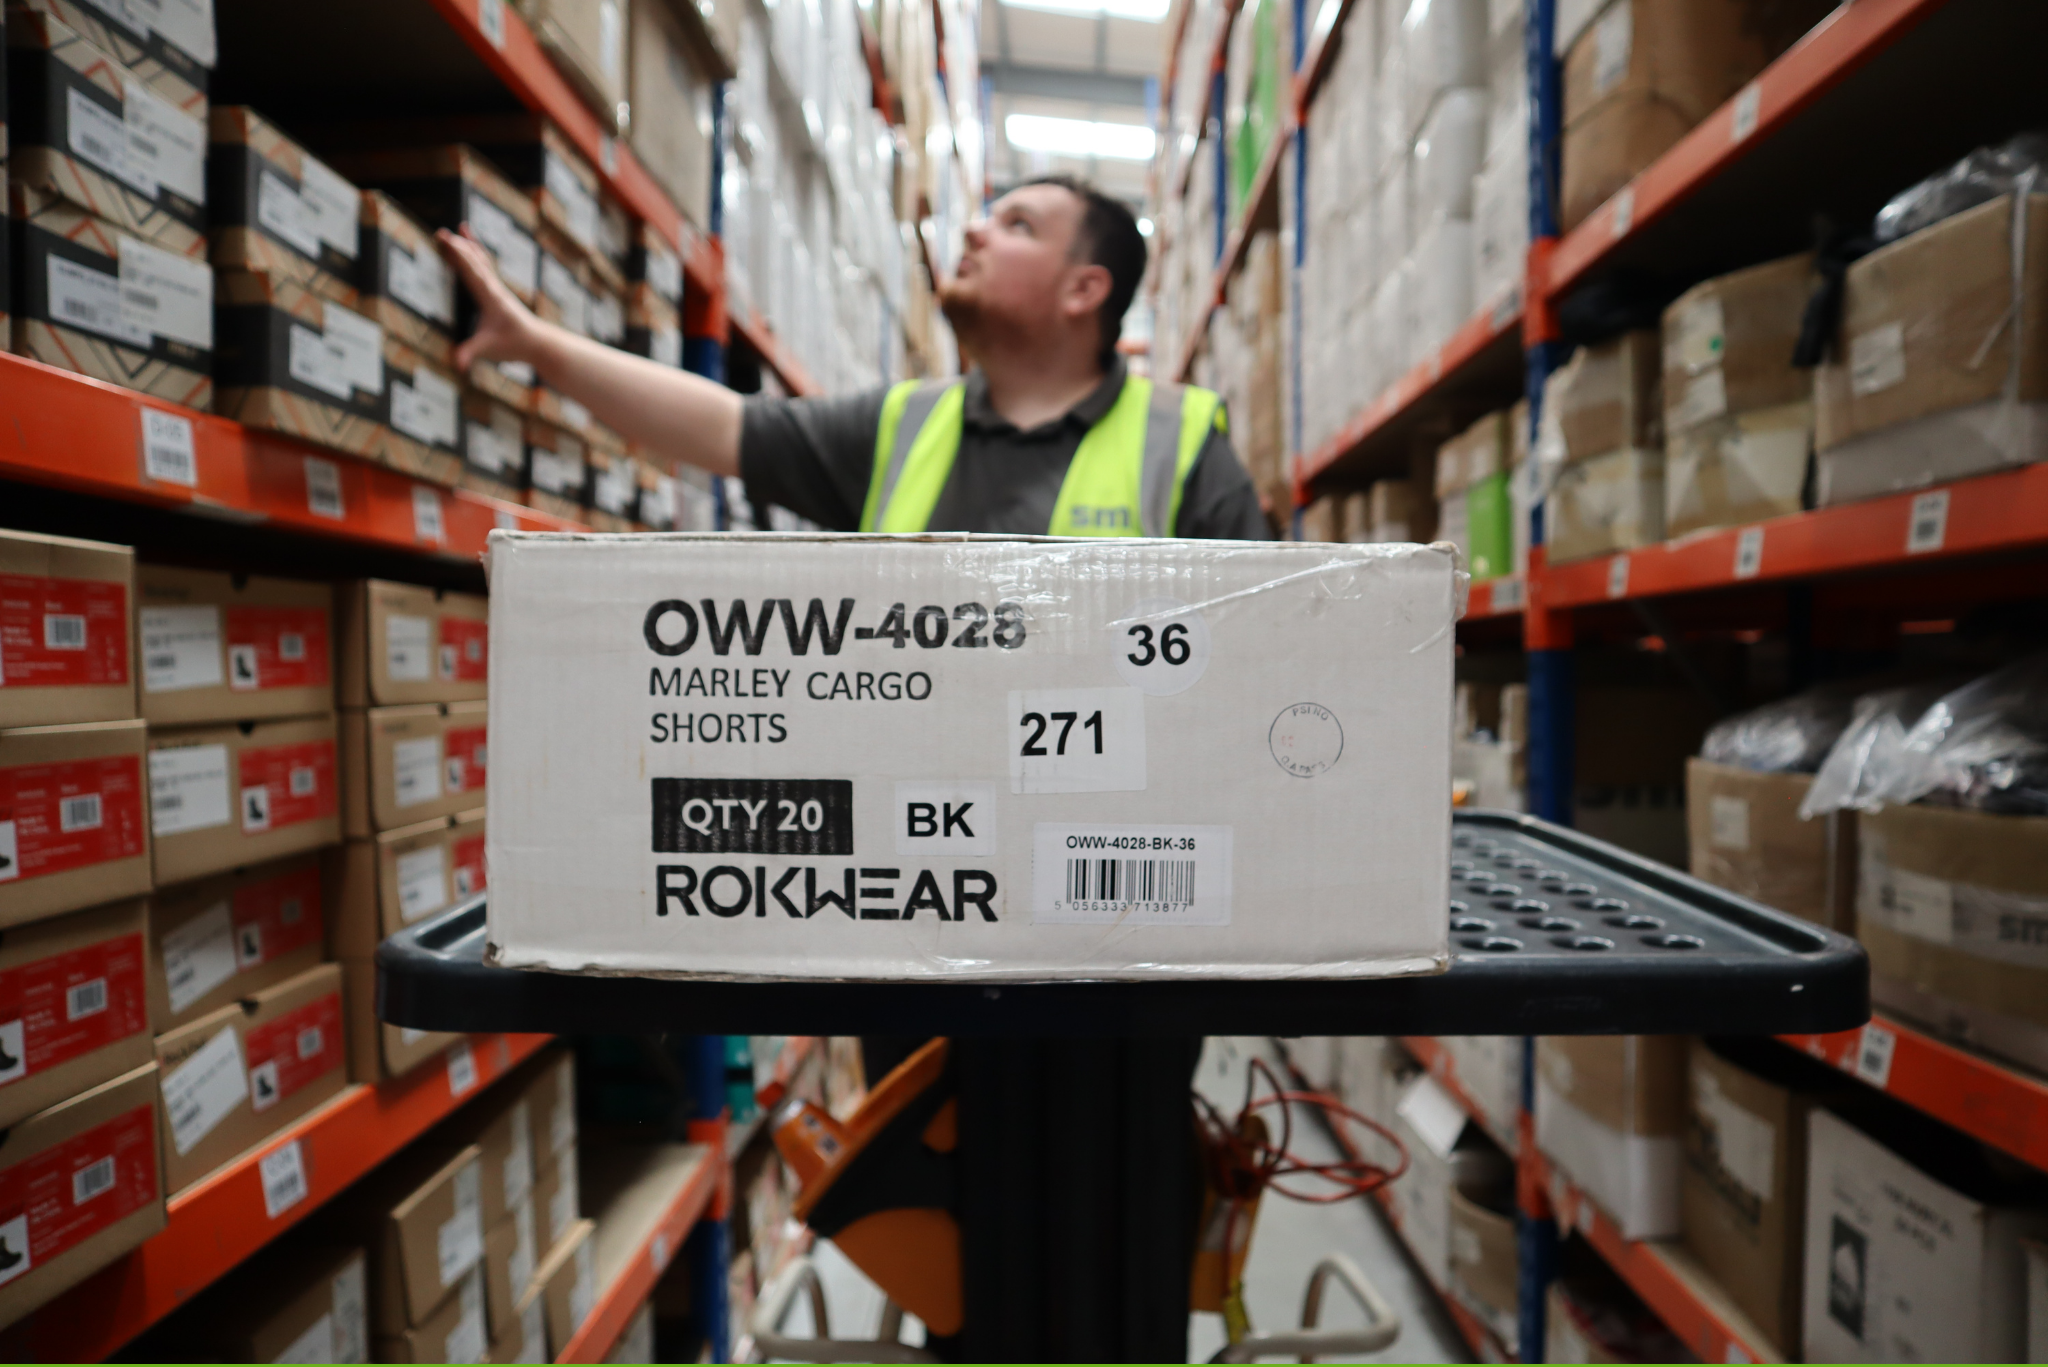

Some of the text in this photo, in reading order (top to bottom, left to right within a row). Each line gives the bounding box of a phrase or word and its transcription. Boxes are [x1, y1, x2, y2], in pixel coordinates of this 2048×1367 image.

[643, 598, 1027, 657] OWW-4028
[1127, 623, 1191, 667] 36
[649, 667, 932, 701] MARLEY CARGO
[650, 712, 788, 744] SHORTS
[1020, 710, 1103, 757] 271
[681, 798, 823, 836] QTY 20
[907, 802, 975, 838] BK
[1066, 835, 1196, 851] OWW-4028-BK-36
[656, 864, 999, 923] ROKWEAR
